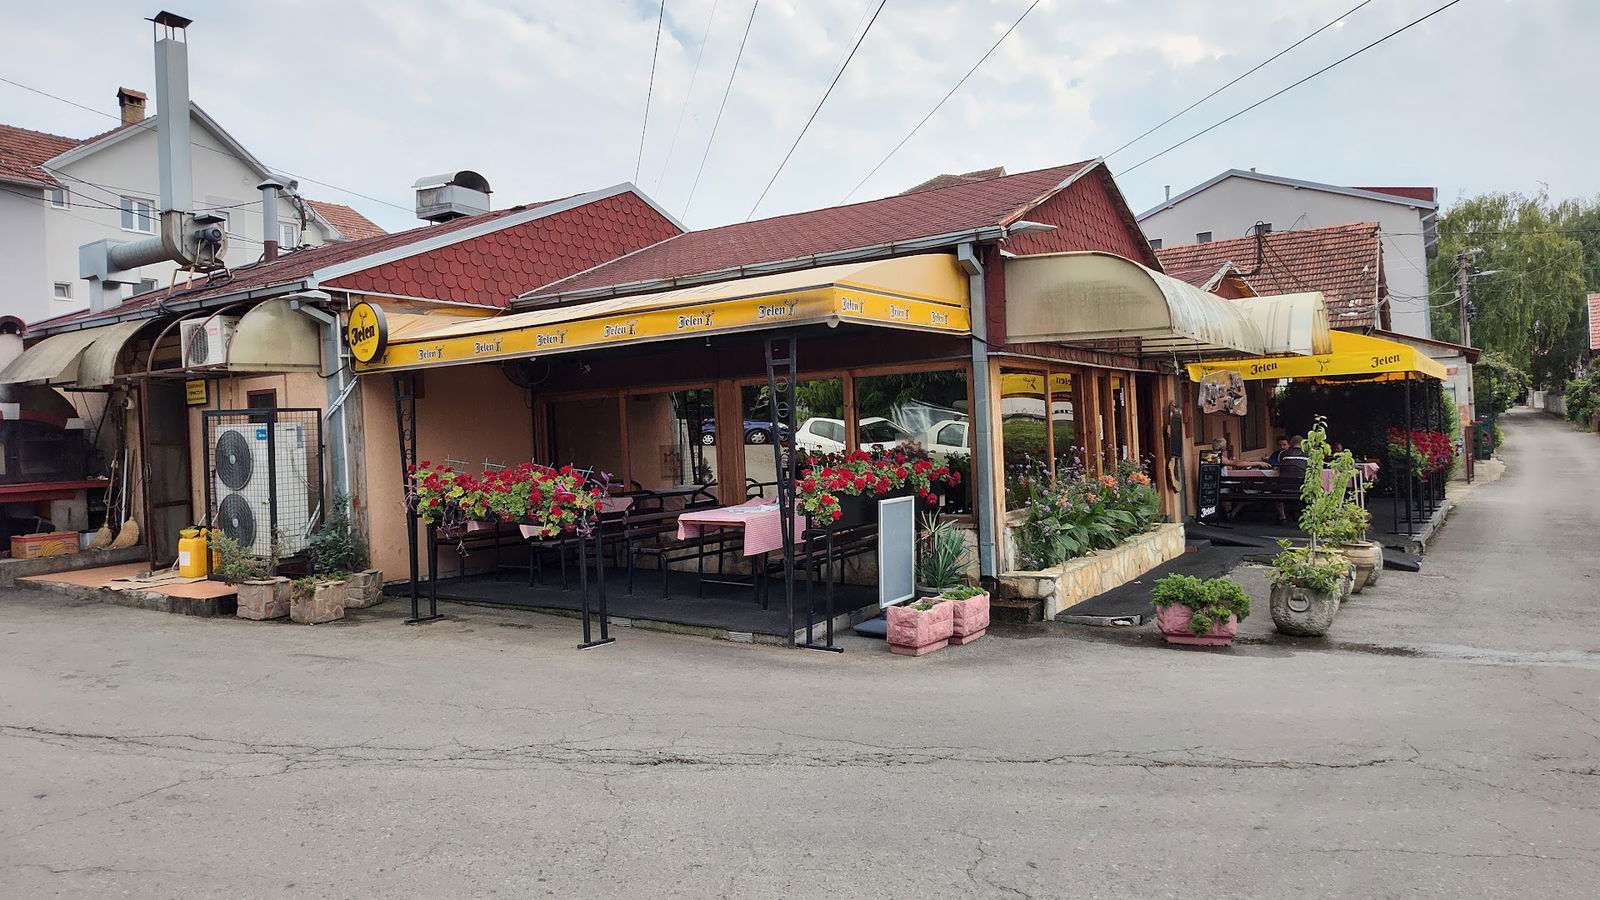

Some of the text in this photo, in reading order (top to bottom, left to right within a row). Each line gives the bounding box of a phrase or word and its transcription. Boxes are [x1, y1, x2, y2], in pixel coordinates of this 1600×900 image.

[841, 296, 859, 312] Jelen
[758, 305, 785, 319] Jelen
[678, 315, 703, 329] Jelen
[351, 324, 375, 346] Jelen
[604, 325, 626, 337] Jelen
[537, 334, 558, 346] Jelen
[418, 348, 436, 360] Jelen
[475, 341, 494, 354] Jelen
[1370, 354, 1400, 368] Jelen
[1250, 362, 1277, 375] Jelen
